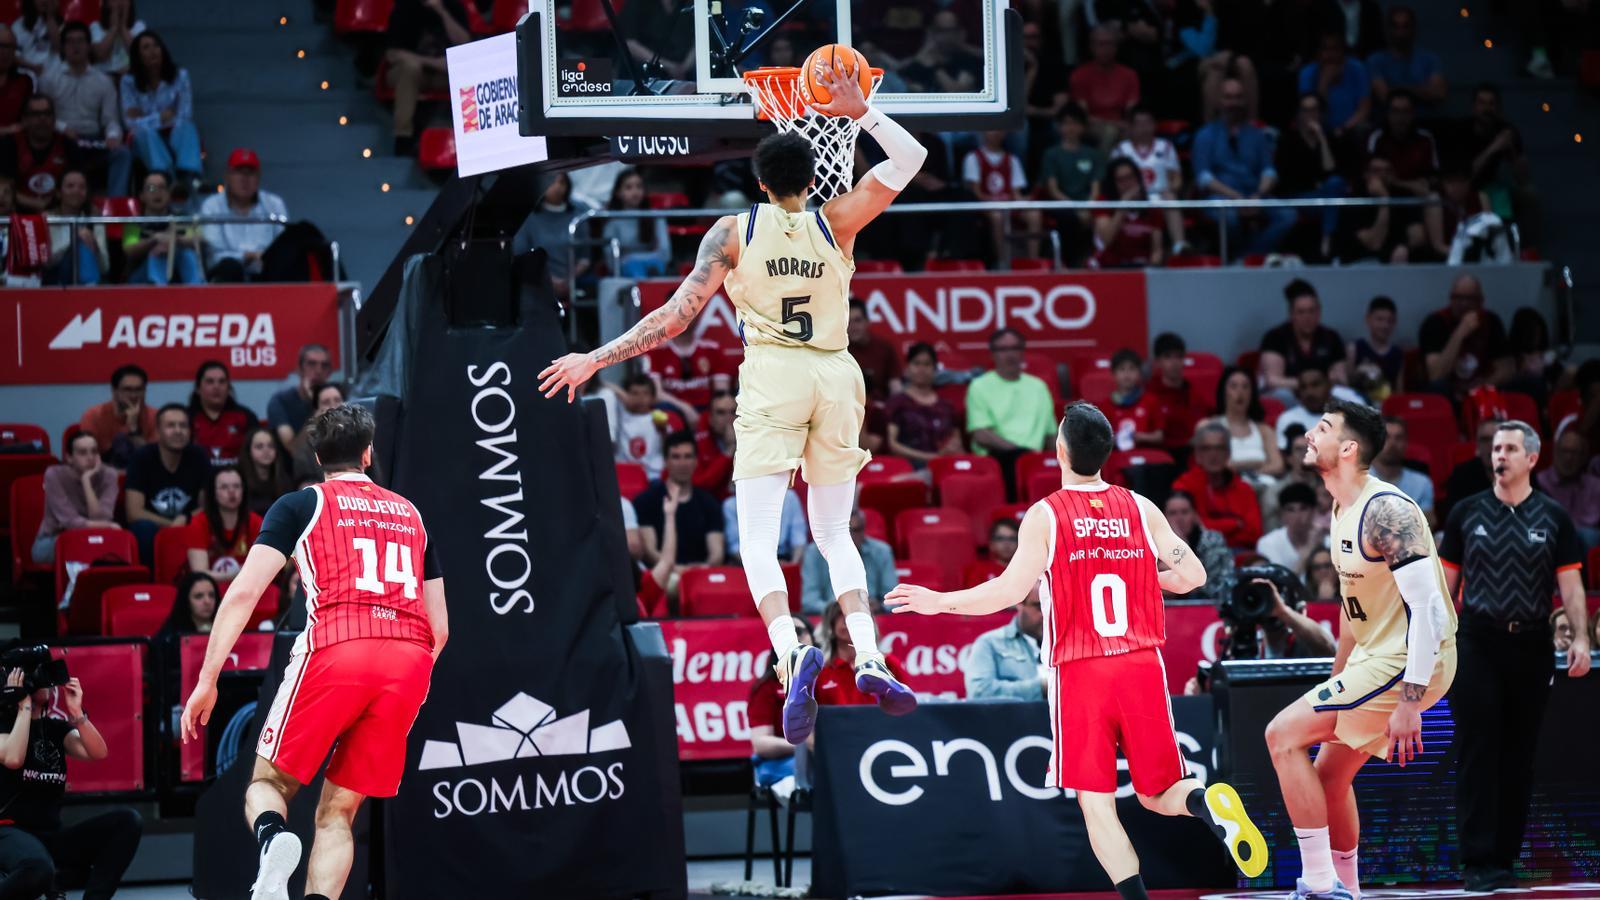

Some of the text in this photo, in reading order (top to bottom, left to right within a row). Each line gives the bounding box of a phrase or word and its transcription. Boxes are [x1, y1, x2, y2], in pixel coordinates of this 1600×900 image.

[561, 70, 585, 82] liga
[562, 81, 612, 93] endesa
[477, 76, 519, 105] GOBIERN
[479, 107, 491, 130] DE
[765, 257, 825, 279] NORRIS
[781, 295, 813, 342] 5
[108, 314, 277, 349] AGREDA
[231, 347, 277, 367] BUS
[467, 361, 535, 616] SOMMOS
[336, 495, 411, 518] DUBLJEVIC
[336, 518, 416, 536] AIR HORIZONT
[1073, 517, 1130, 539] SPISSU
[1069, 547, 1145, 562] AIR HORIZONT
[352, 537, 418, 600] 14
[1090, 573, 1128, 638] 0
[432, 762, 625, 820] SOMMOS
